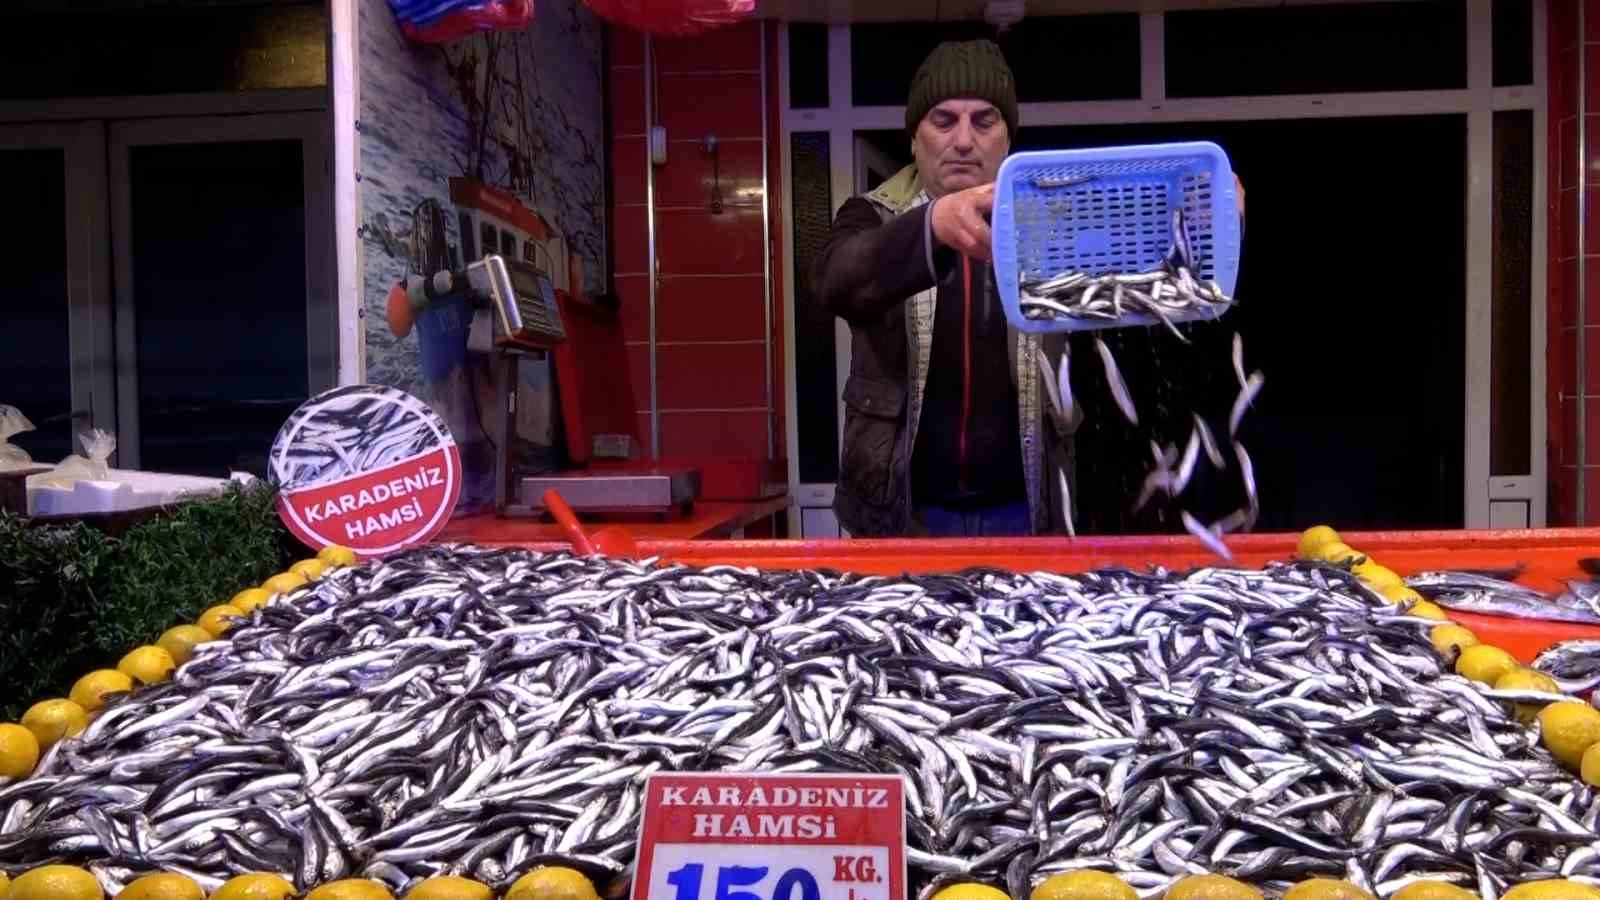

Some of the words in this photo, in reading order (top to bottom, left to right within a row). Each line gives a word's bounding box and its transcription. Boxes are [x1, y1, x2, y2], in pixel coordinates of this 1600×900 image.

[304, 466, 444, 524] KARADENİZ
[345, 497, 424, 540] HAMSİ
[660, 782, 889, 808] KARADENİZ
[832, 855, 882, 883] KG.
